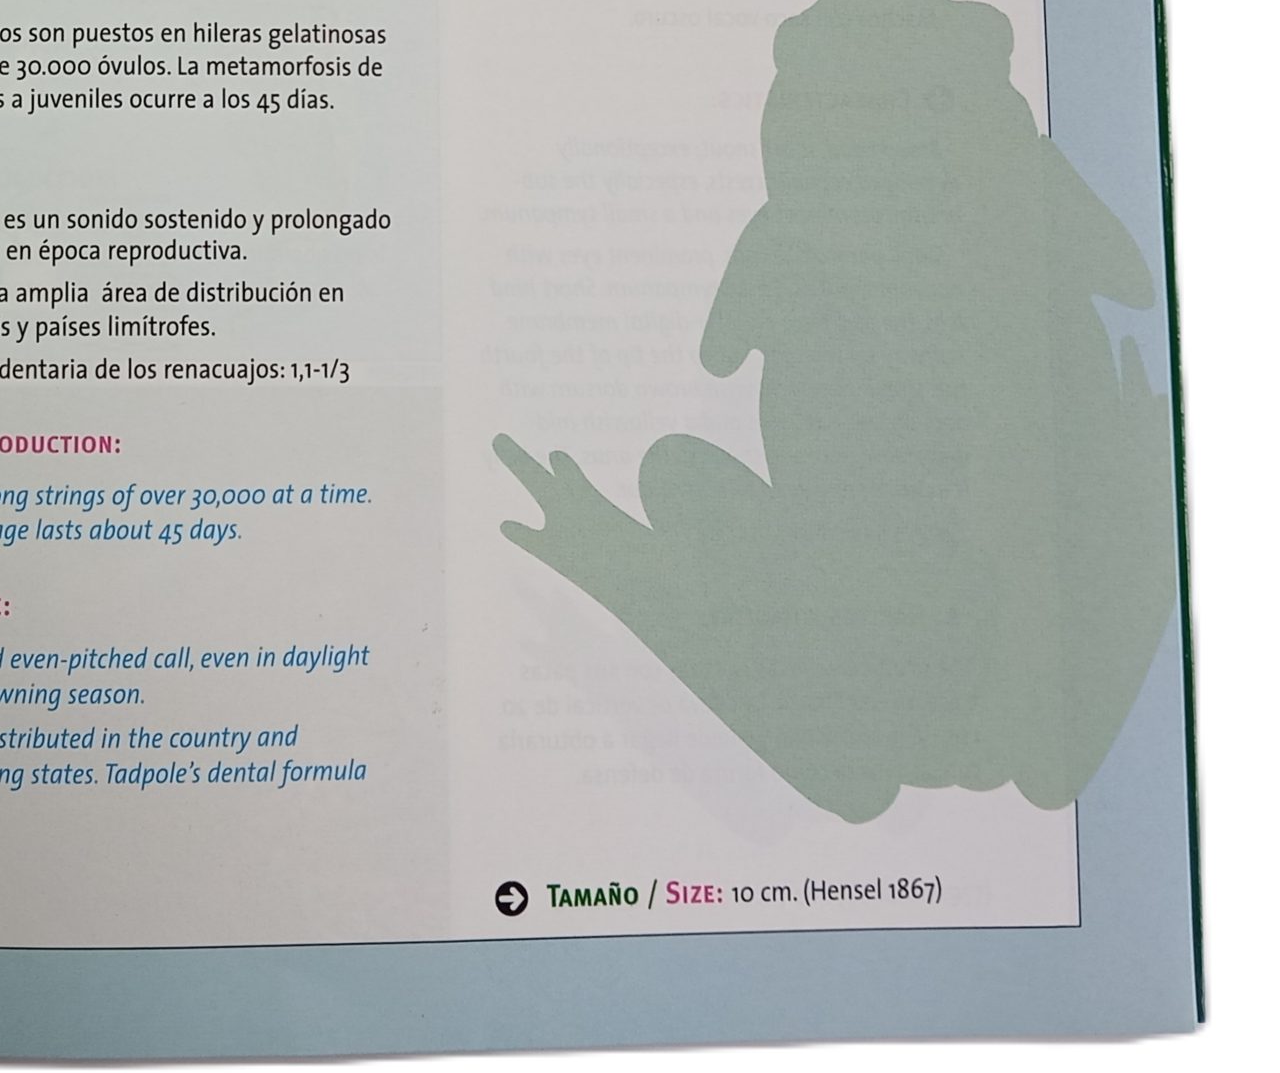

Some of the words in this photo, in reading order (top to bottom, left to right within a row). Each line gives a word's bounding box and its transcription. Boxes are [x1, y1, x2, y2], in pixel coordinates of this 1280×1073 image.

[28, 27, 65, 43] son
[72, 22, 154, 49] puestos
[160, 27, 186, 43] en
[193, 21, 262, 44] hileras
[268, 22, 387, 50] gelatinosas
[546, 881, 639, 908] TAMAÑO
[666, 880, 723, 905] SIZE:
[731, 886, 754, 903] 10
[760, 885, 798, 903] cm.
[803, 877, 882, 907] (Hensel
[888, 875, 942, 905] 1867)
